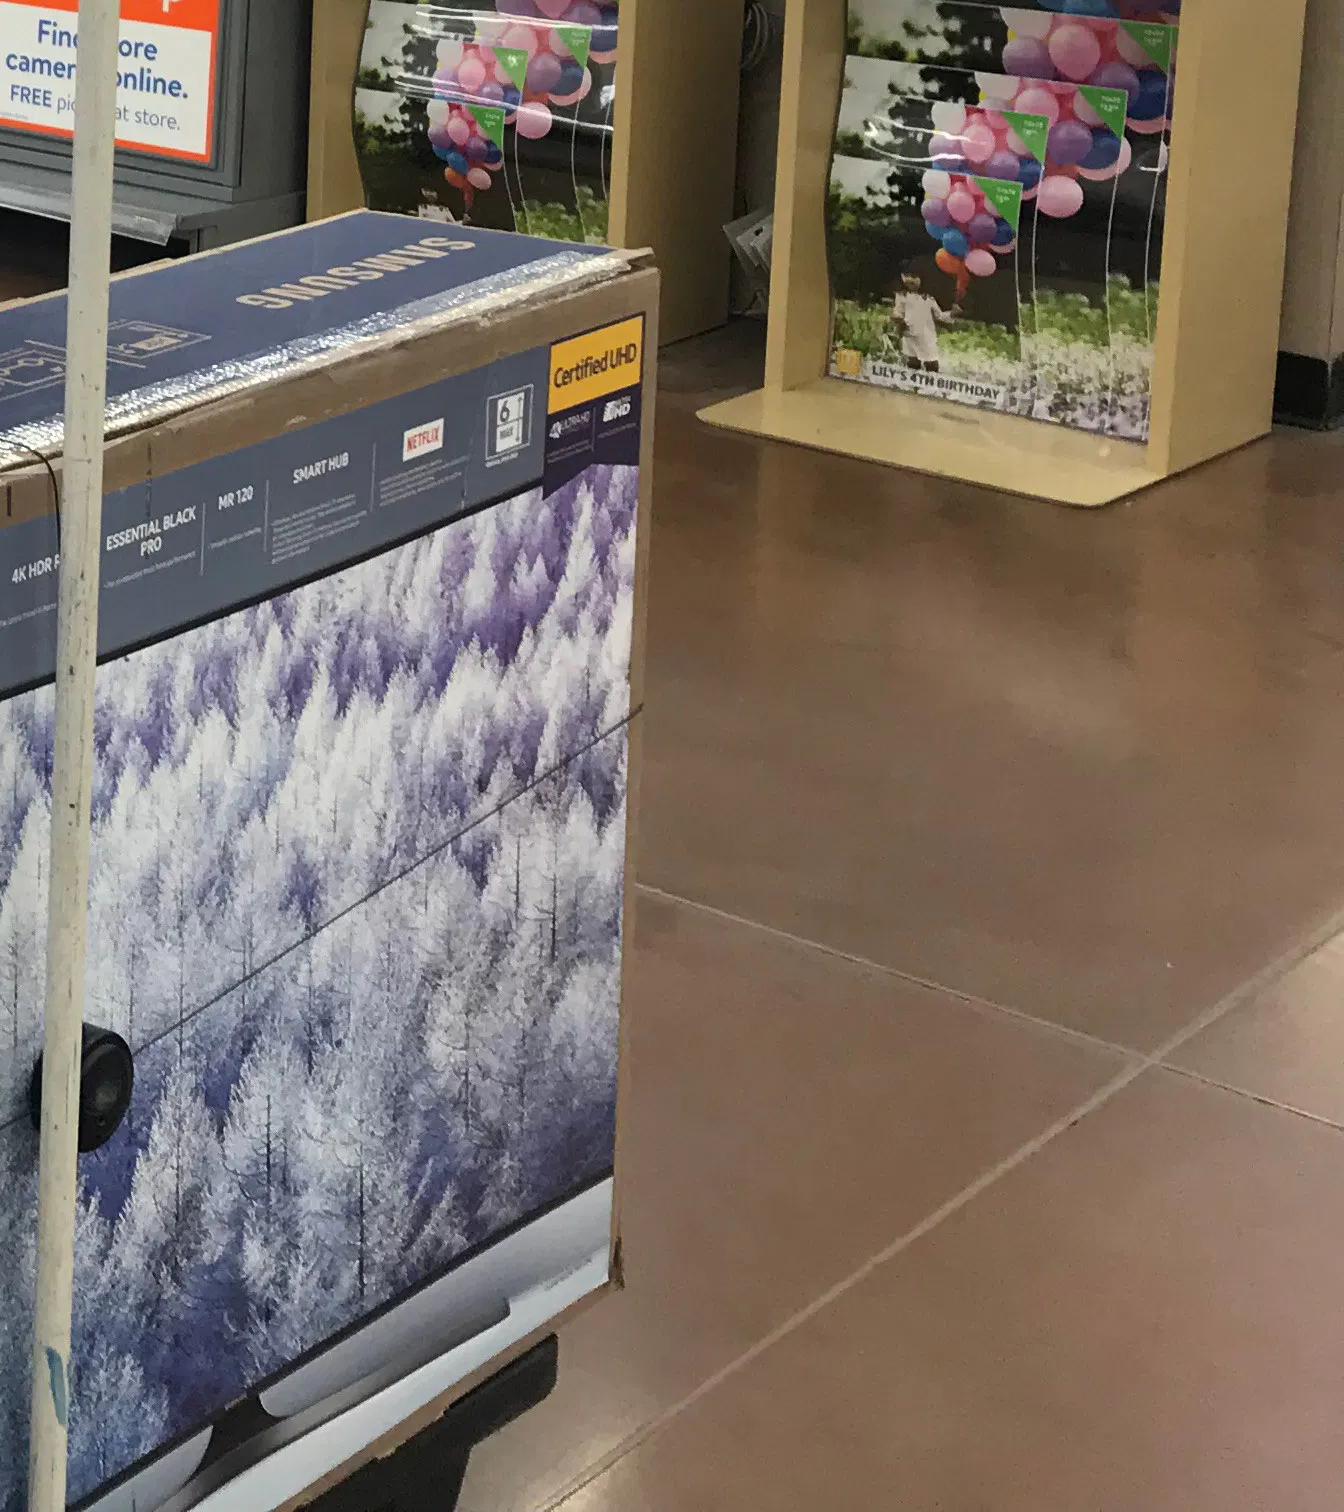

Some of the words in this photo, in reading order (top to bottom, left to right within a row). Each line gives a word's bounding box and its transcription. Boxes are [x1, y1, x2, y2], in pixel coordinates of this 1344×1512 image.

[10, 84, 52, 108] FREE
[134, 105, 181, 132] store.
[235, 236, 476, 309] SAMSUNG
[553, 350, 609, 389] Certified
[609, 342, 638, 370] UHD
[407, 424, 441, 454] NETFLIX
[292, 459, 328, 485] SMART
[328, 451, 350, 471] HUB
[218, 494, 234, 512] MR
[234, 487, 254, 507] 120
[105, 519, 162, 552] ESSENTIAL
[162, 506, 197, 532] BLACK
[140, 537, 163, 557] PRO
[11, 567, 27, 585] 4K
[28, 559, 51, 581] HDR
